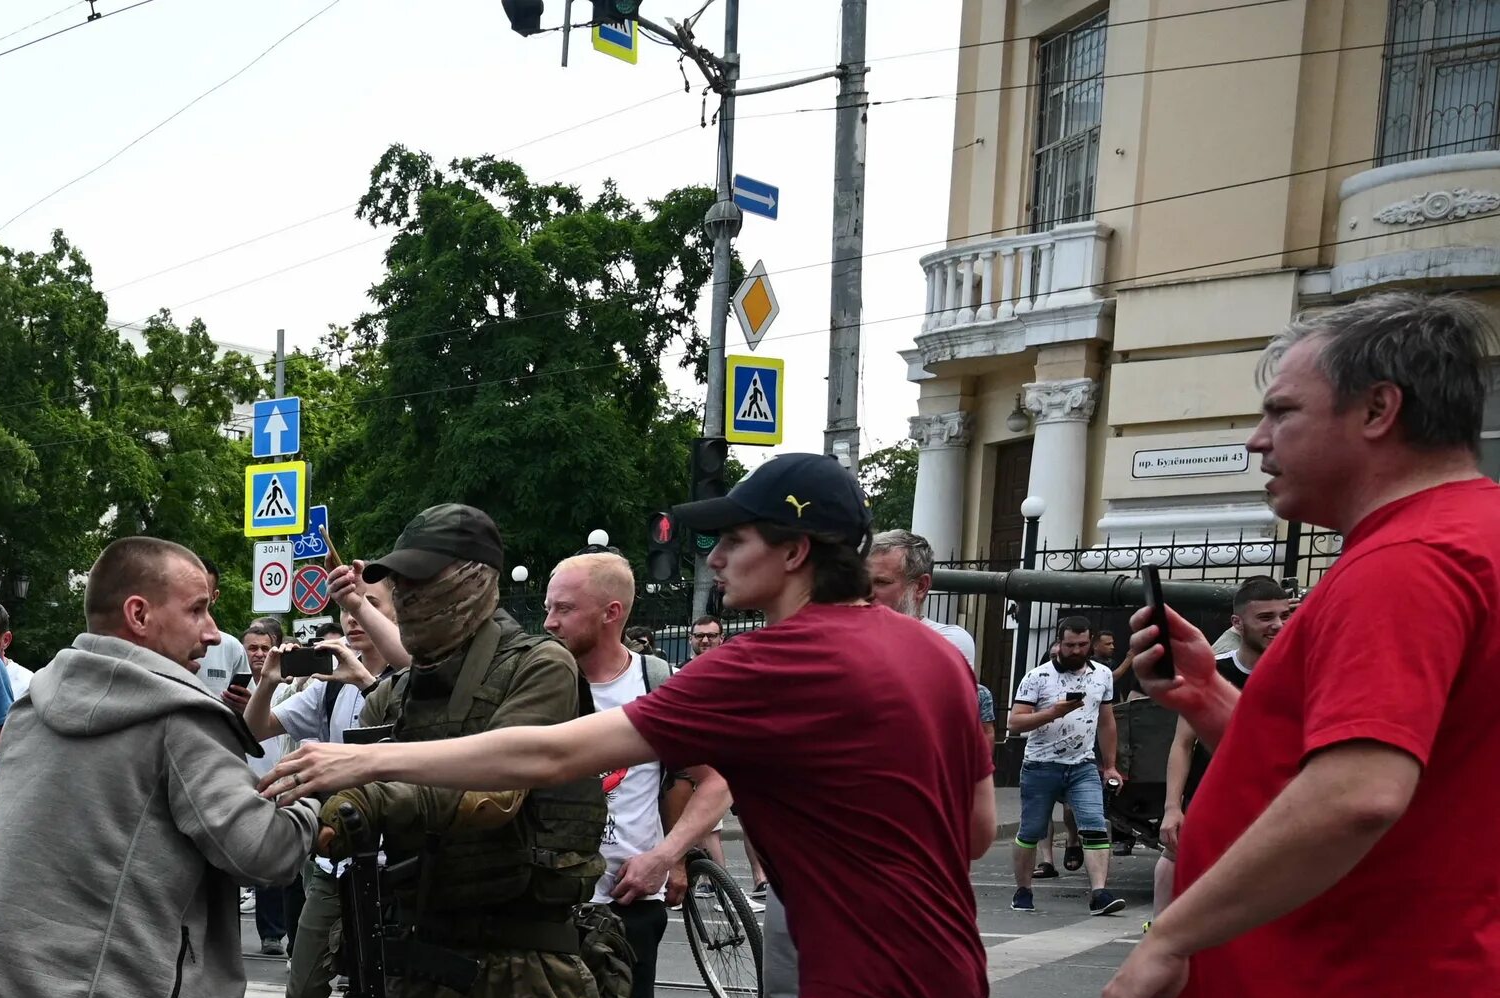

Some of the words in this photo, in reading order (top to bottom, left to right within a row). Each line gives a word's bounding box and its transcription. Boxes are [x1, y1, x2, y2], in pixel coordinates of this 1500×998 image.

[1138, 461, 1154, 469] пр.
[1231, 452, 1243, 461] 43
[263, 545, 286, 554] ЗОНА
[265, 572, 282, 586] 30
